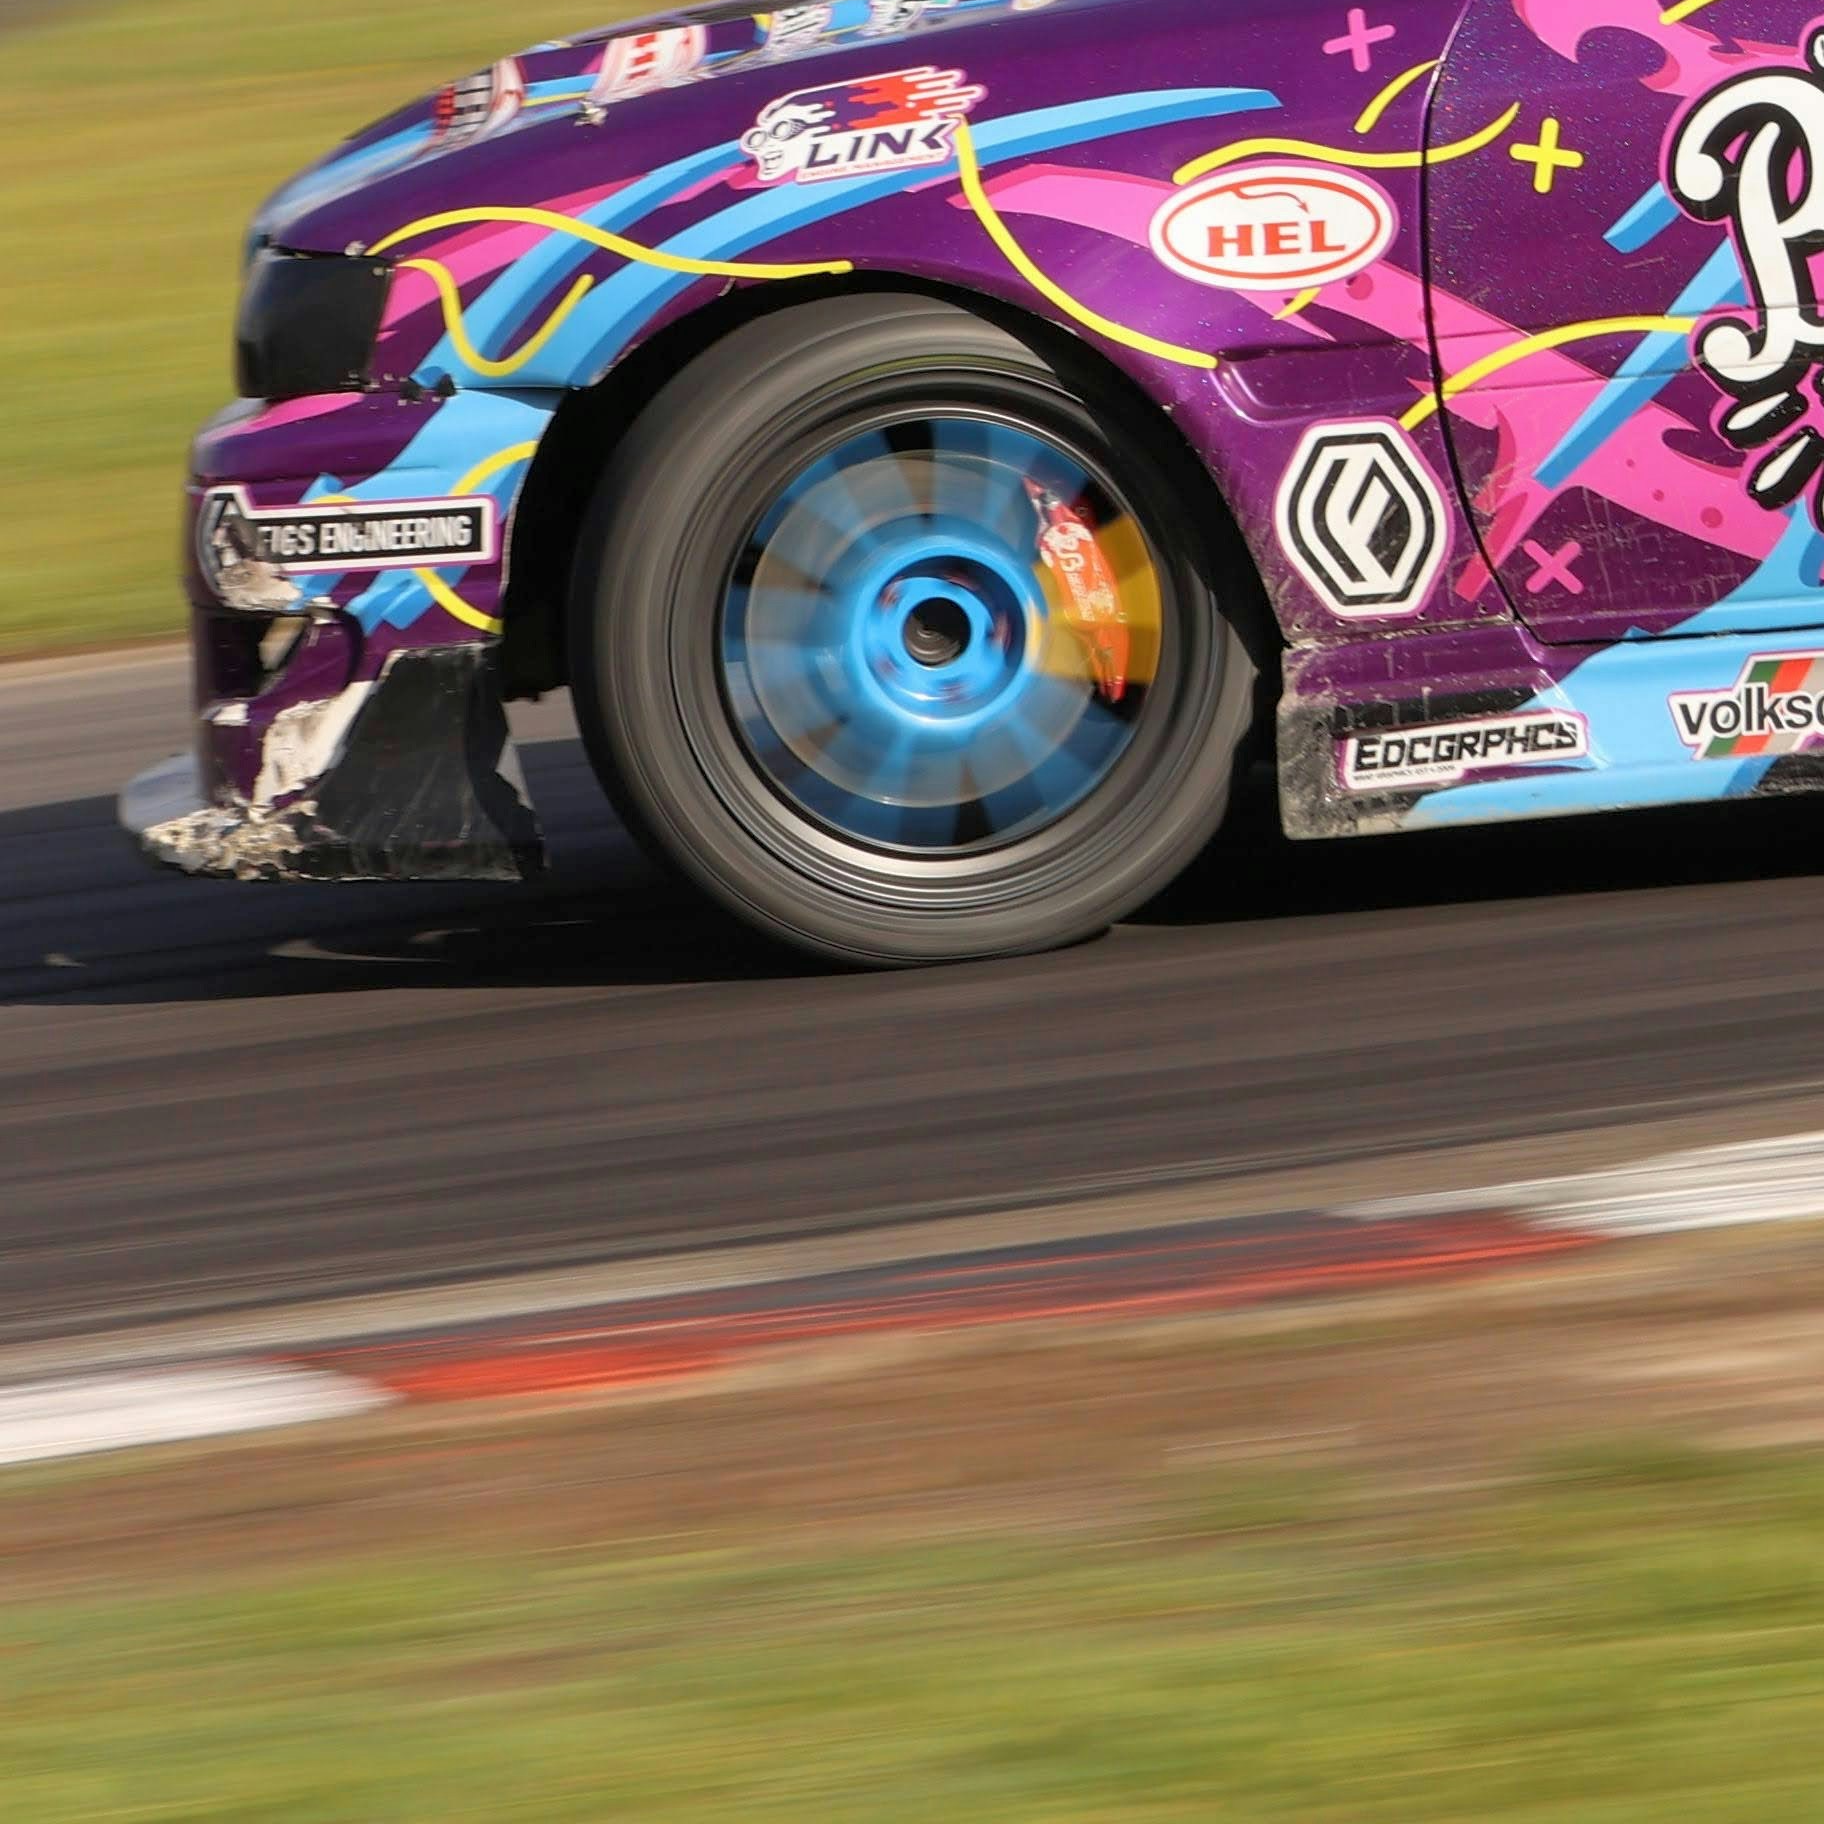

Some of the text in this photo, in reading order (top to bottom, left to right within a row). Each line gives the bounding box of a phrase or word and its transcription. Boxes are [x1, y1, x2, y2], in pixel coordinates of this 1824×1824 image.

[805, 122, 952, 169] LINK
[1207, 219, 1346, 258] HEL
[256, 514, 472, 557] FIGS ENGINEERING
